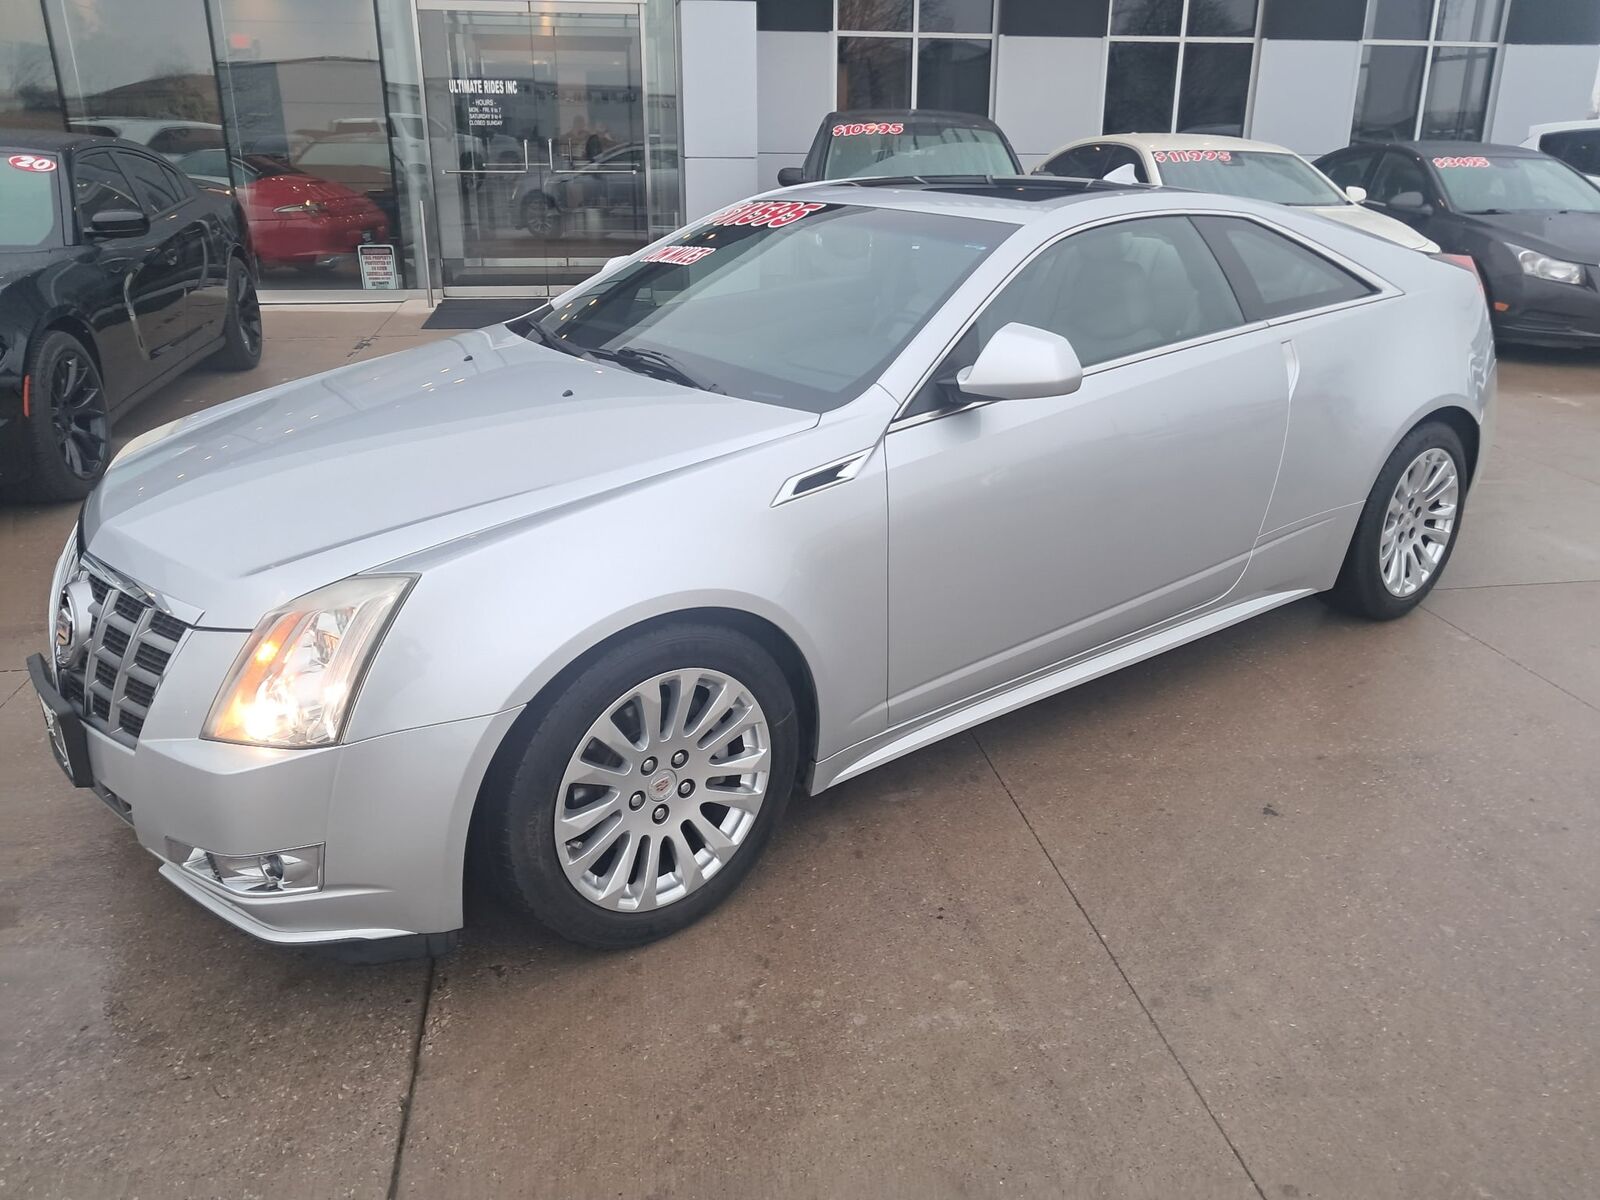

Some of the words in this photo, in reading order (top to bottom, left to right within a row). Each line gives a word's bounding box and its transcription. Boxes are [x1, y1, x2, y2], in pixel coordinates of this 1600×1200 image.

[448, 79, 483, 94] ULTIMATE
[483, 80, 504, 95] RIDES
[505, 80, 518, 95] INC
[832, 123, 904, 136] $10995
[15, 155, 51, 169] 20
[1154, 150, 1231, 163] $11995
